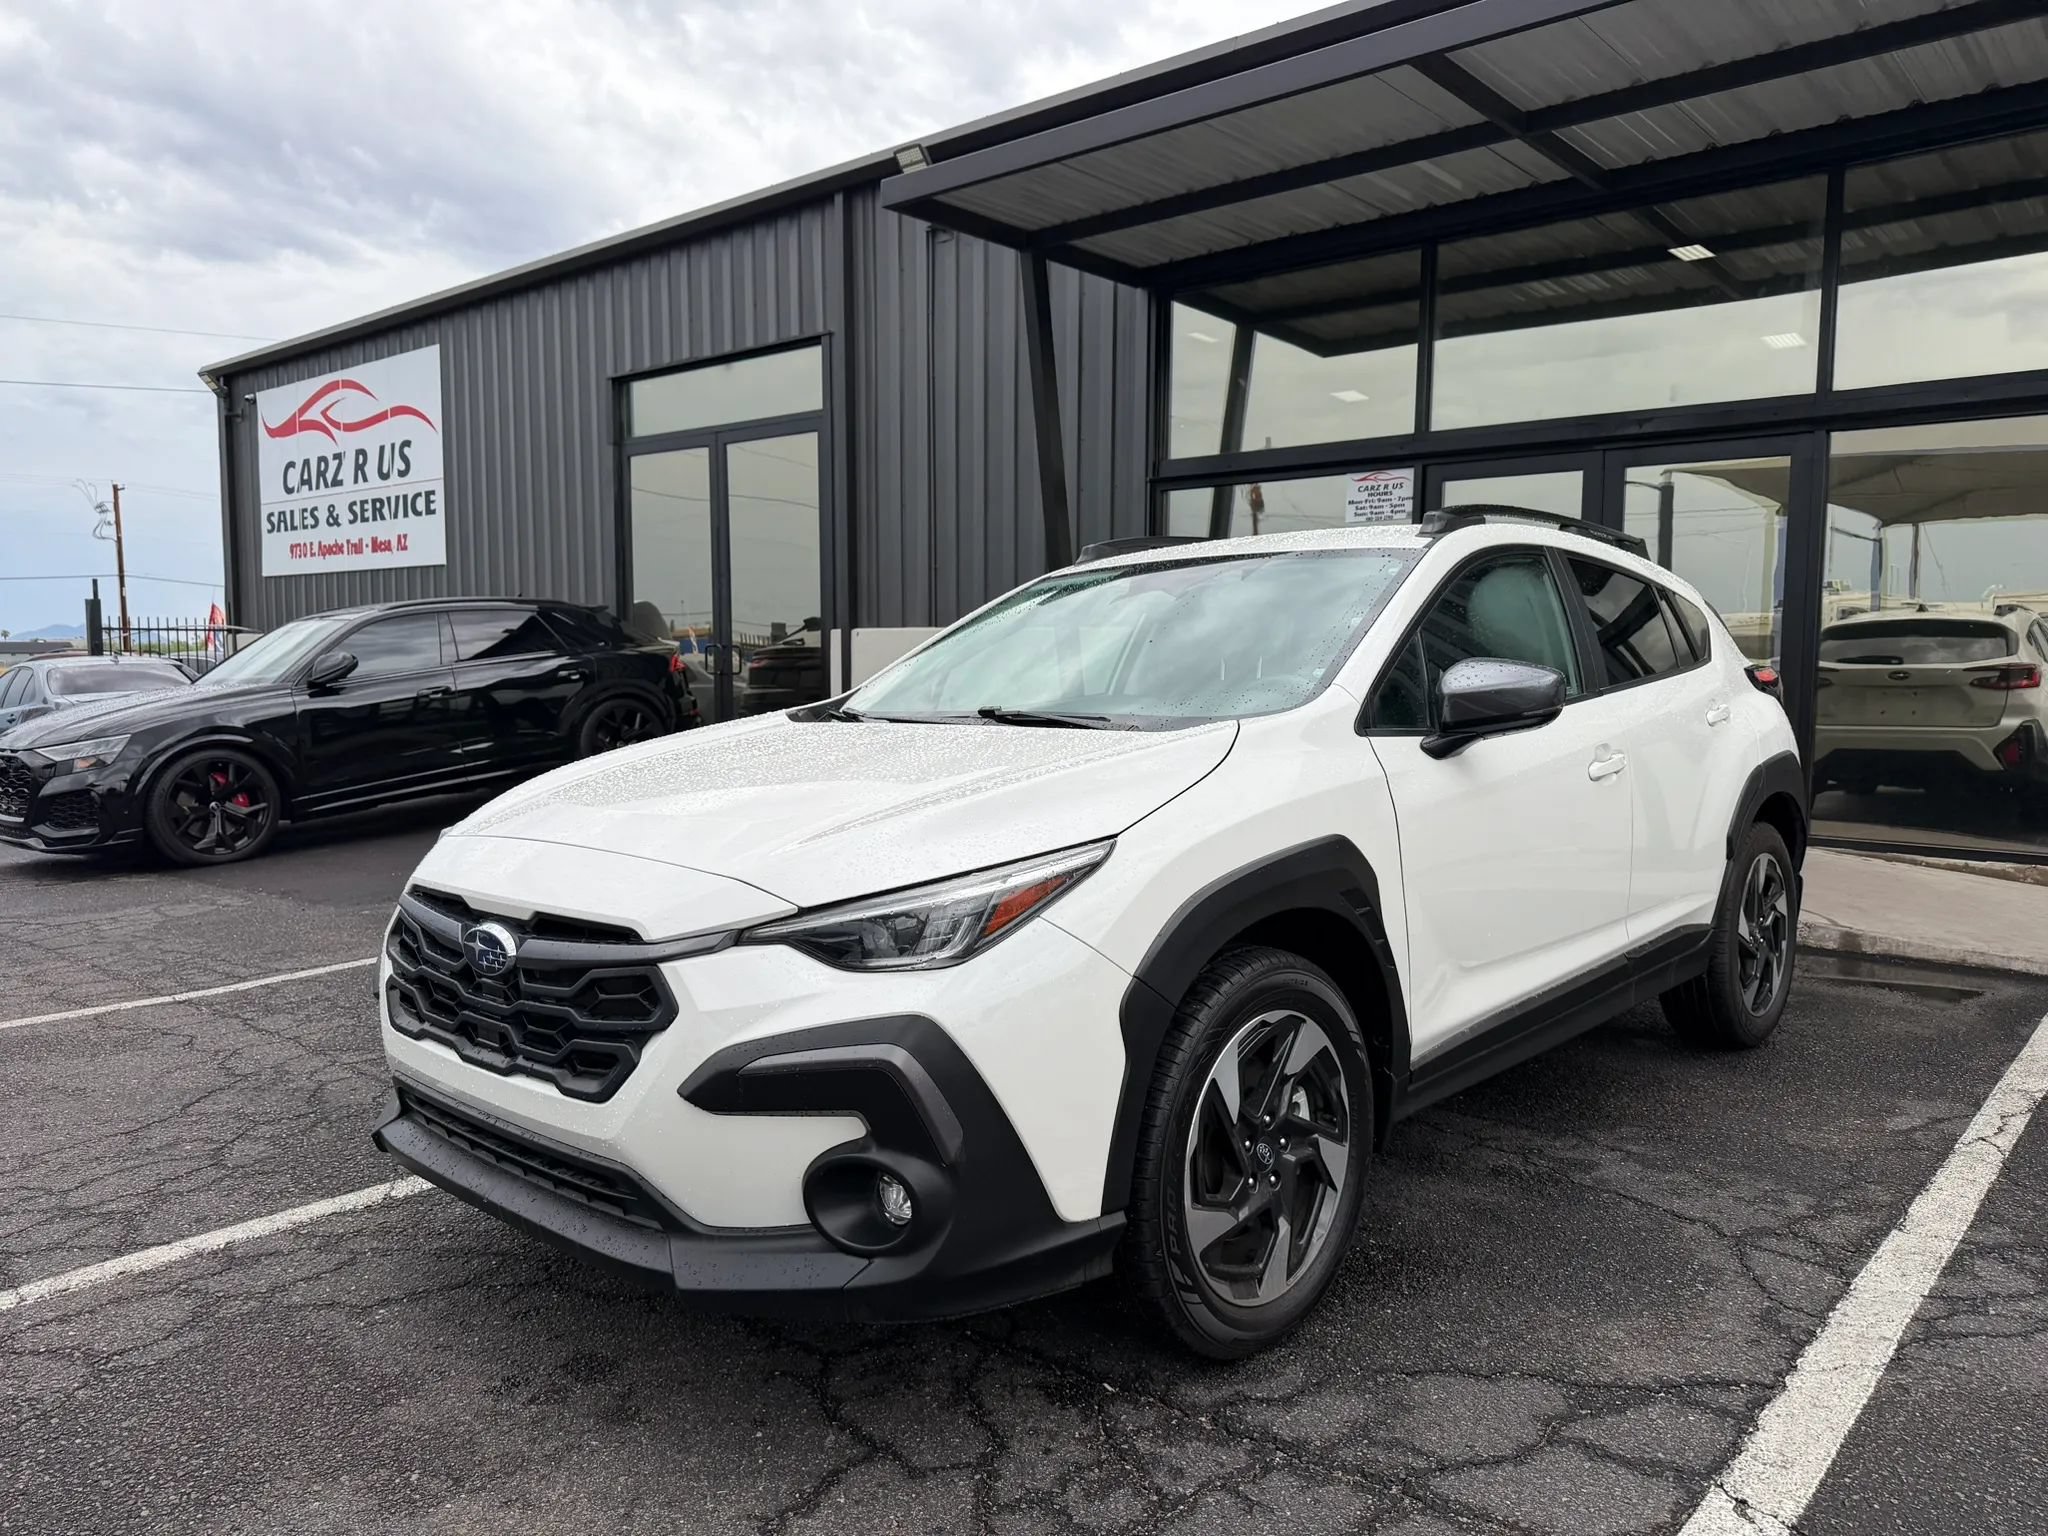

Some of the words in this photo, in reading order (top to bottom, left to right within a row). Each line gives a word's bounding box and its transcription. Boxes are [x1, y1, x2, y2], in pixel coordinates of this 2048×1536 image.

[282, 450, 346, 495] CARZ
[353, 448, 368, 484] R
[377, 439, 412, 481] US
[1357, 484, 1381, 492] CARZ
[266, 505, 320, 534] SALES
[325, 503, 342, 528] &
[347, 490, 437, 525] SERVICE
[318, 538, 344, 559] Apache
[346, 537, 364, 555] Trail
[396, 533, 408, 551] AZ
